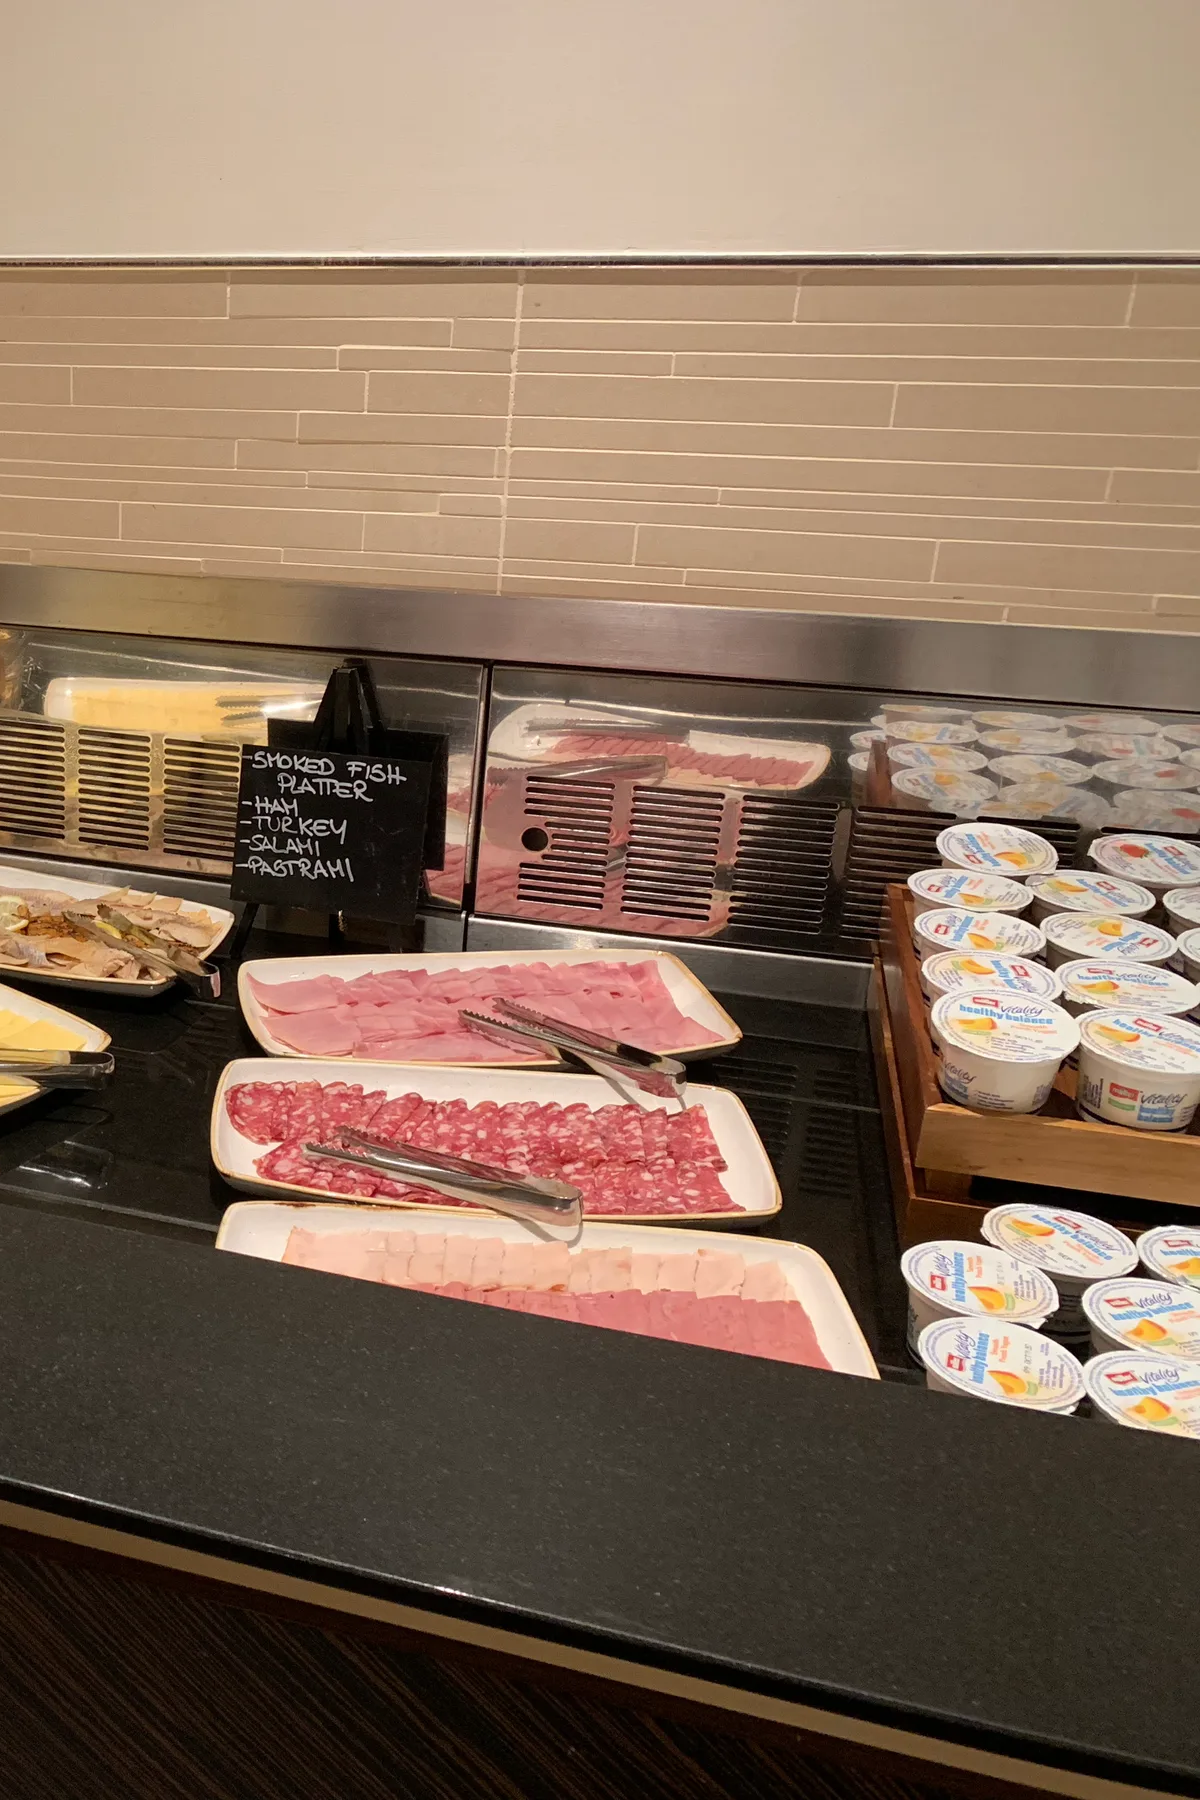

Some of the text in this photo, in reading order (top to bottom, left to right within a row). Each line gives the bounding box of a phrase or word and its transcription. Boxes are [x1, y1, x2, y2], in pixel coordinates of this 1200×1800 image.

[252, 751, 407, 785] SMOKED FISH
[277, 772, 373, 802] PLATTER
[254, 795, 299, 817] HAM
[252, 815, 347, 845] TURKEY
[249, 834, 320, 857] SALAMI
[248, 856, 354, 883] PASTRAMI
[959, 1003, 1054, 1025] healthy balance
[1000, 1005, 1047, 1018] Vitality
[1136, 1292, 1174, 1309] Vitality
[1140, 1368, 1180, 1384] Vitality
